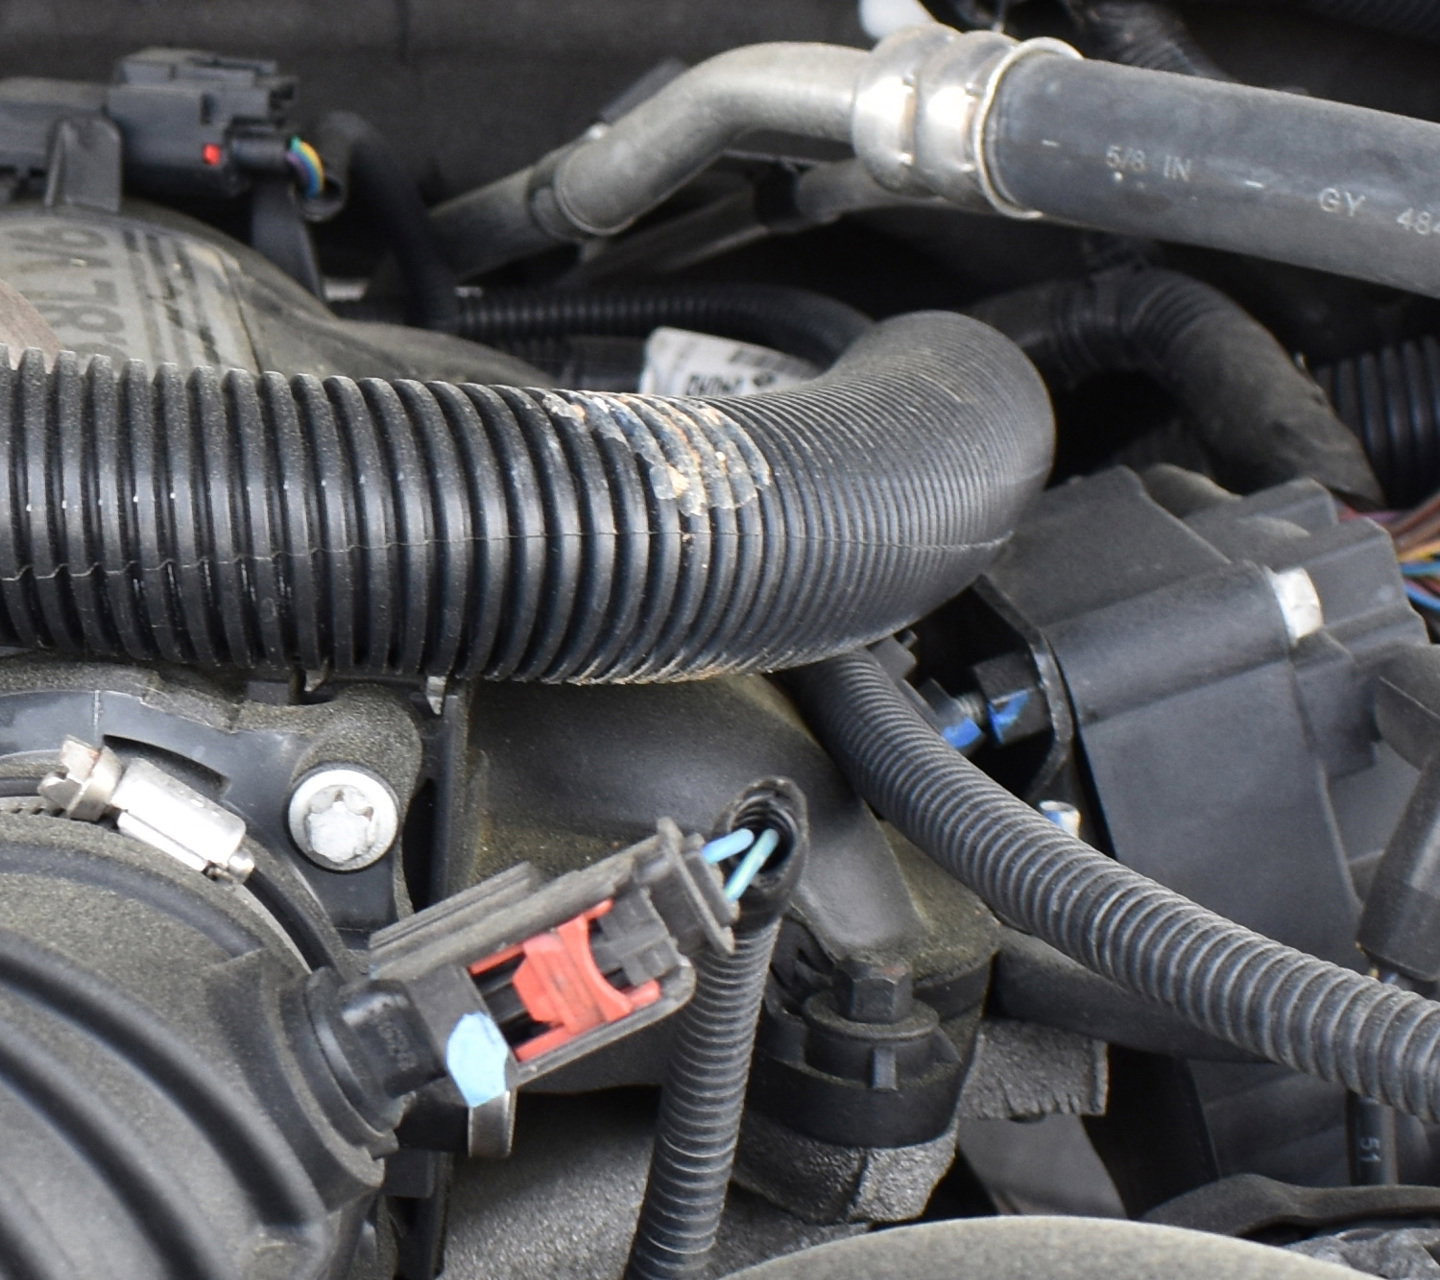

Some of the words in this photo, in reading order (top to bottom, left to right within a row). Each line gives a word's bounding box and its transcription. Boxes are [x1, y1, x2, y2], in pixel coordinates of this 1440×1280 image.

[1105, 145, 1147, 174] 5/8
[1163, 155, 1192, 183] IN
[1320, 187, 1366, 218] GY
[1358, 1136, 1382, 1163] 51
